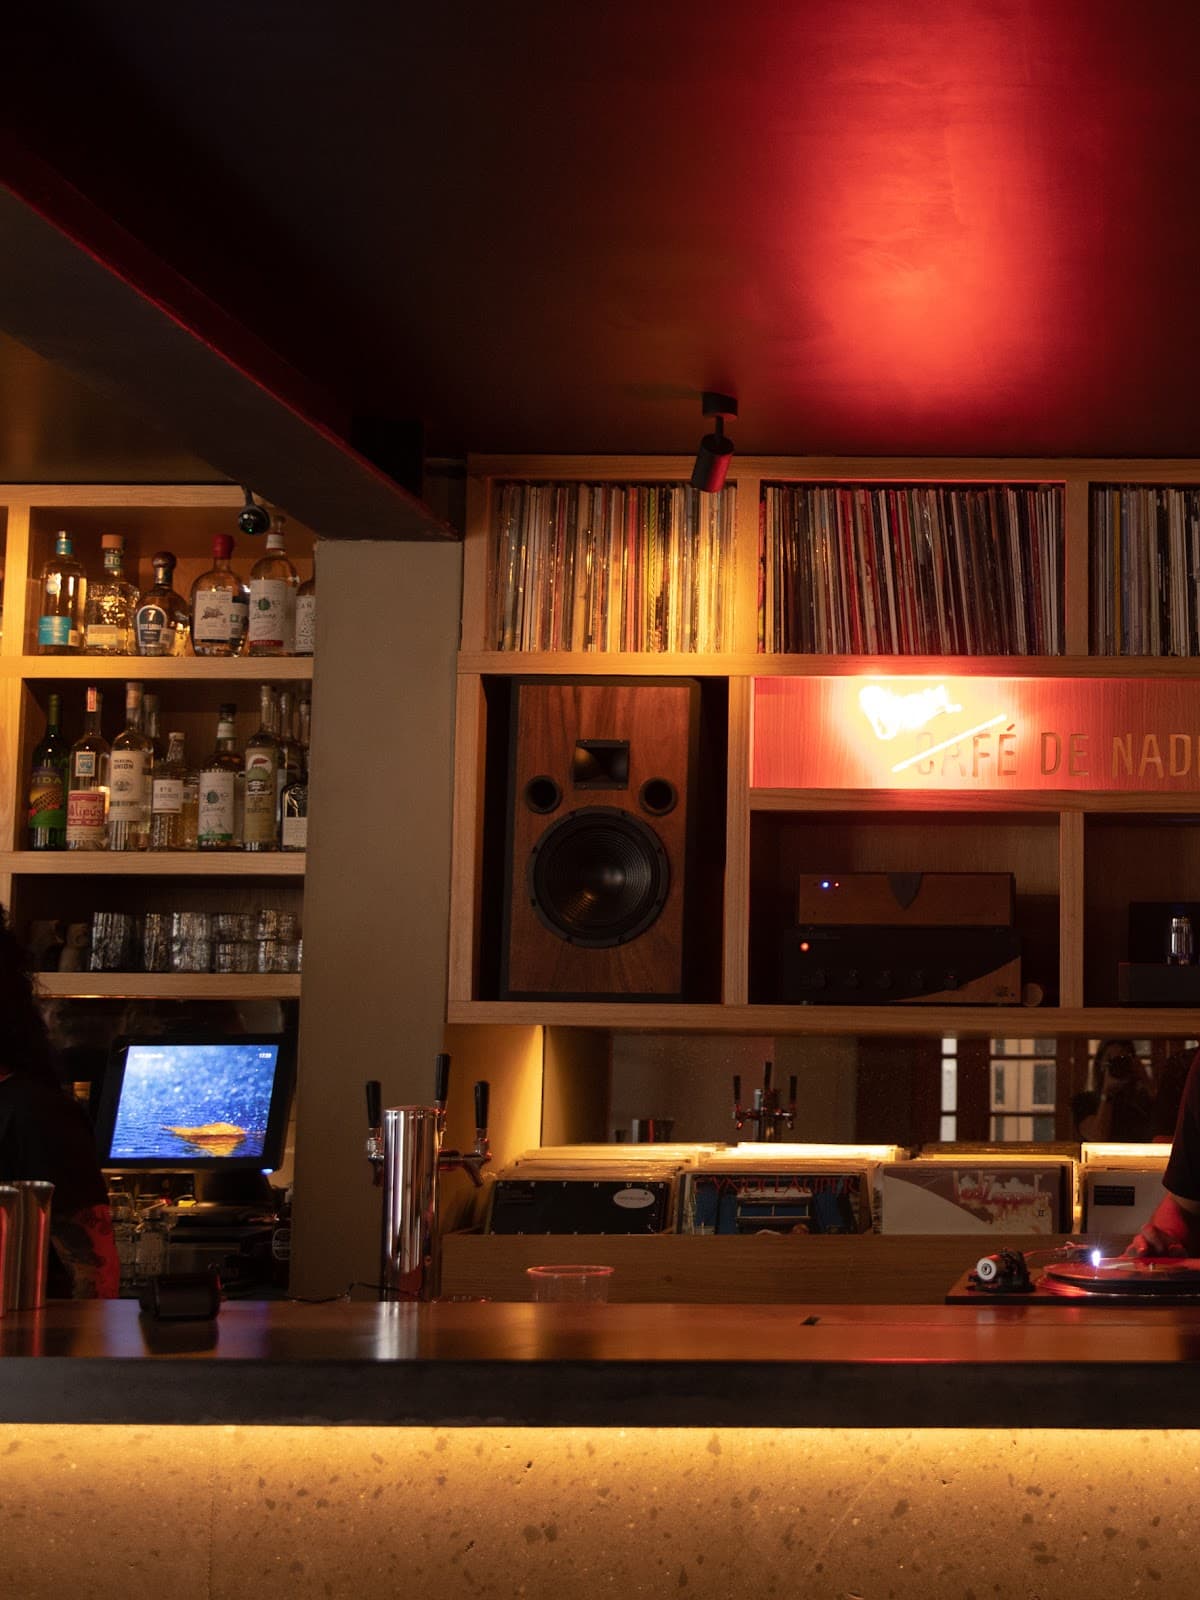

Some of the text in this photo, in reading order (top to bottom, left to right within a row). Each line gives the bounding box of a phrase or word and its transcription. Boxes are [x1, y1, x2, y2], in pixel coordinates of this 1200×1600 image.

[148, 610, 156, 621] 7
[916, 724, 1016, 777] CAFÉ
[1040, 732, 1089, 777] DE
